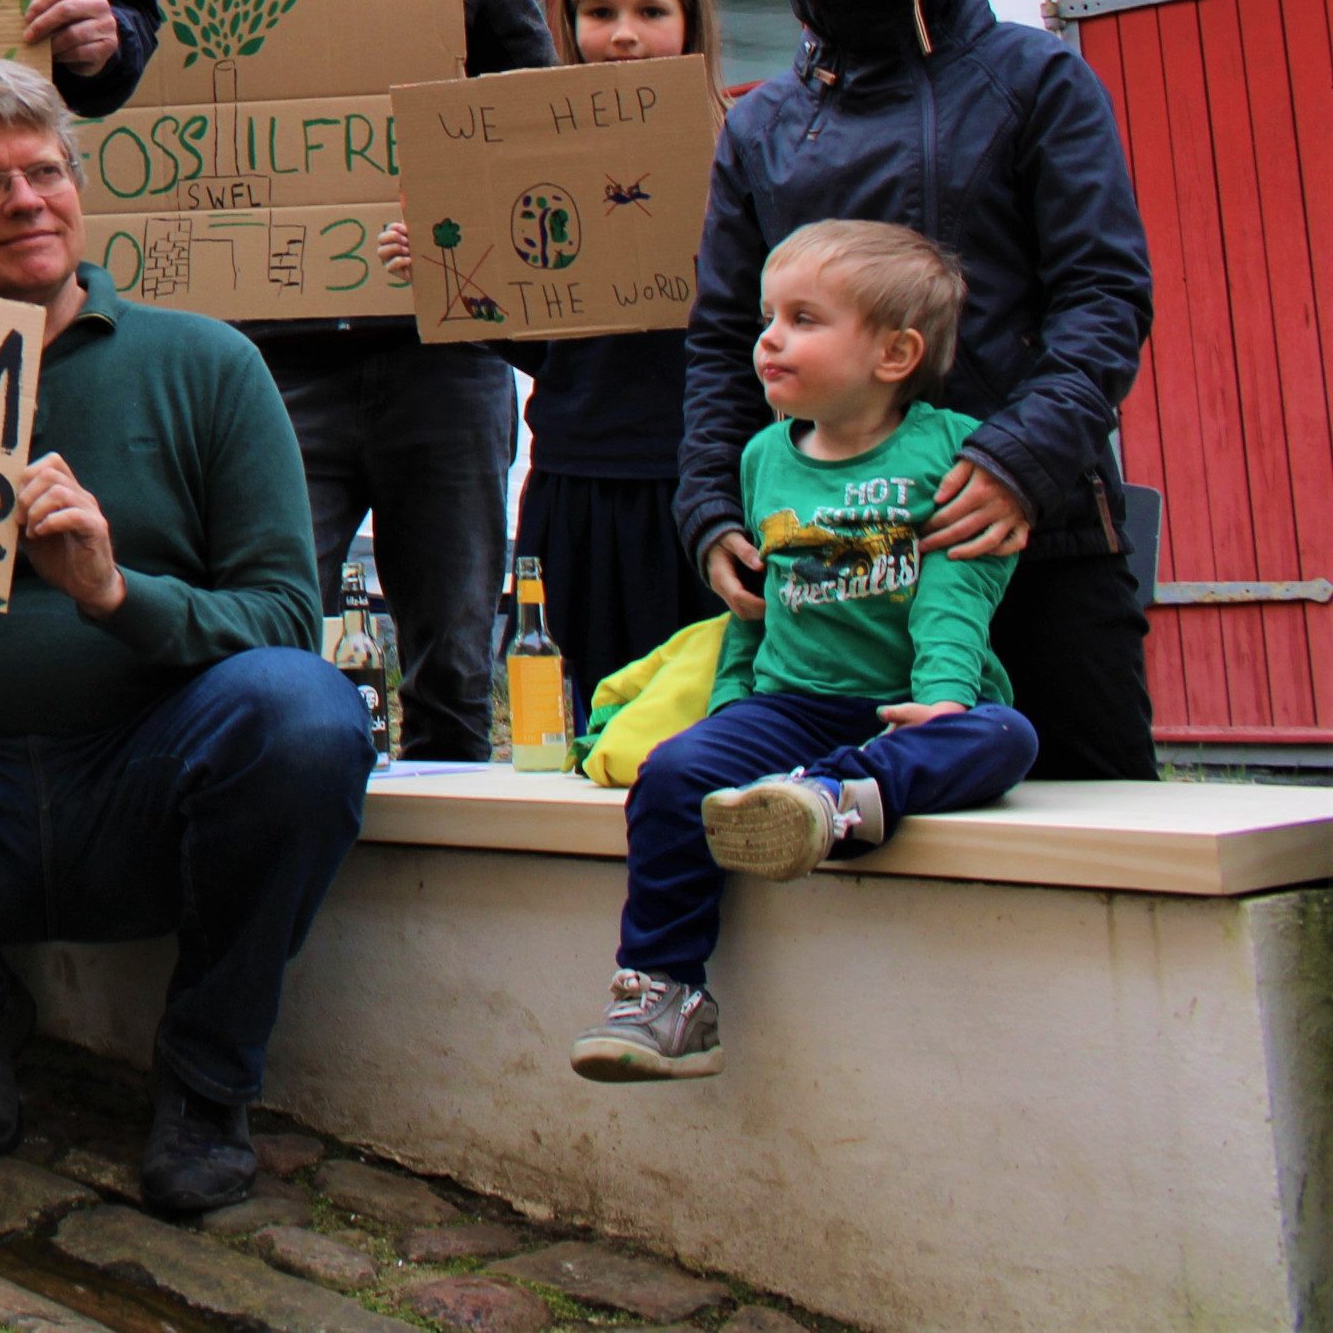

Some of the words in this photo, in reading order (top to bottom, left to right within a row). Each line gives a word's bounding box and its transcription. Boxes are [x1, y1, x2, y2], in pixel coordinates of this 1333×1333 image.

[438, 105, 503, 143] WE
[549, 86, 656, 135] HELP
[187, 181, 262, 210] SWFL
[507, 281, 585, 325] THE
[844, 477, 915, 507] HOT
